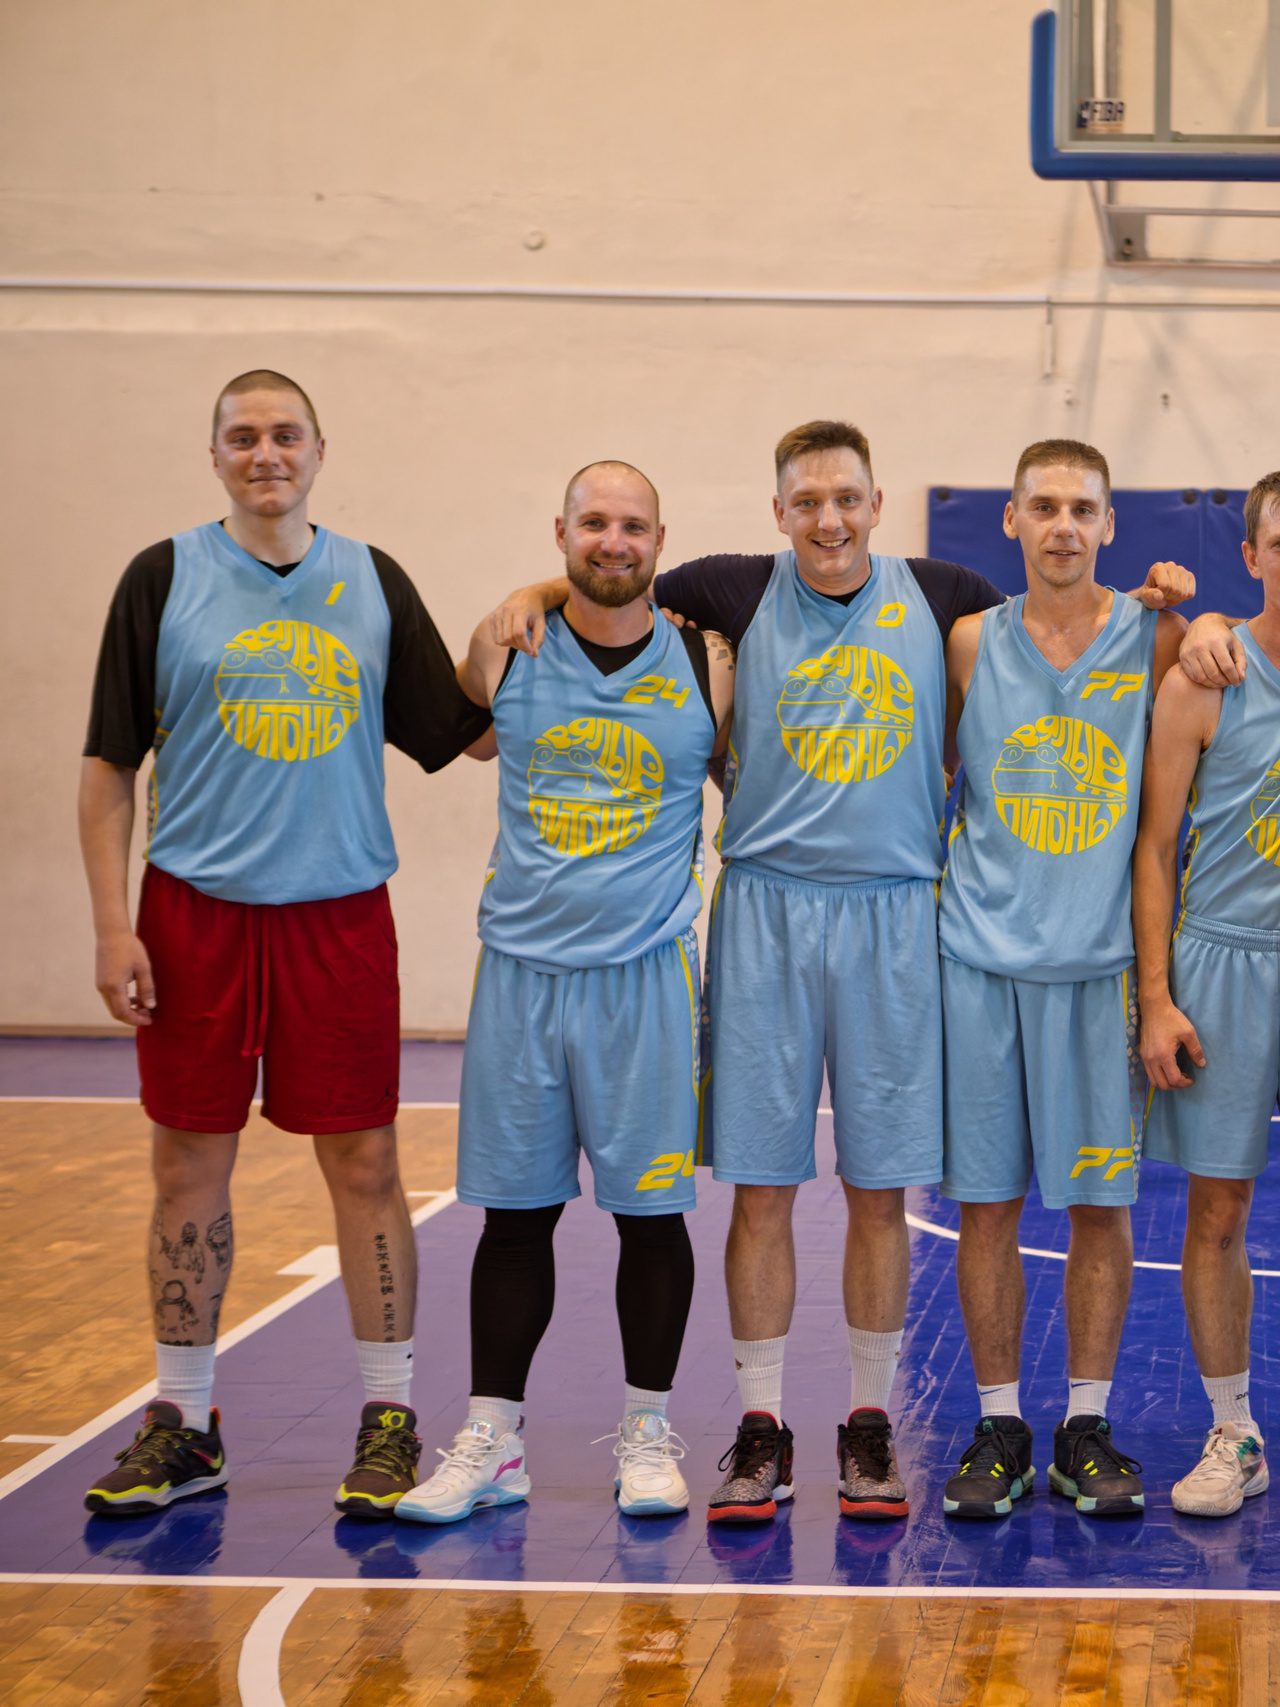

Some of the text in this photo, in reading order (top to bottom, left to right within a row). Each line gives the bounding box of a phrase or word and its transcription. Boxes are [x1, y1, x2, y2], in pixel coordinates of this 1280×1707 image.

[325, 581, 346, 606] 1
[621, 675, 691, 708] 24
[1080, 670, 1147, 701] 77
[218, 703, 359, 762] ПИТОНЫ
[781, 729, 912, 784] ПИТОНЫ
[528, 798, 660, 857] ПИТОНЫ
[995, 795, 1127, 855] ПИТОНЫ
[1069, 1146, 1133, 1180] 77
